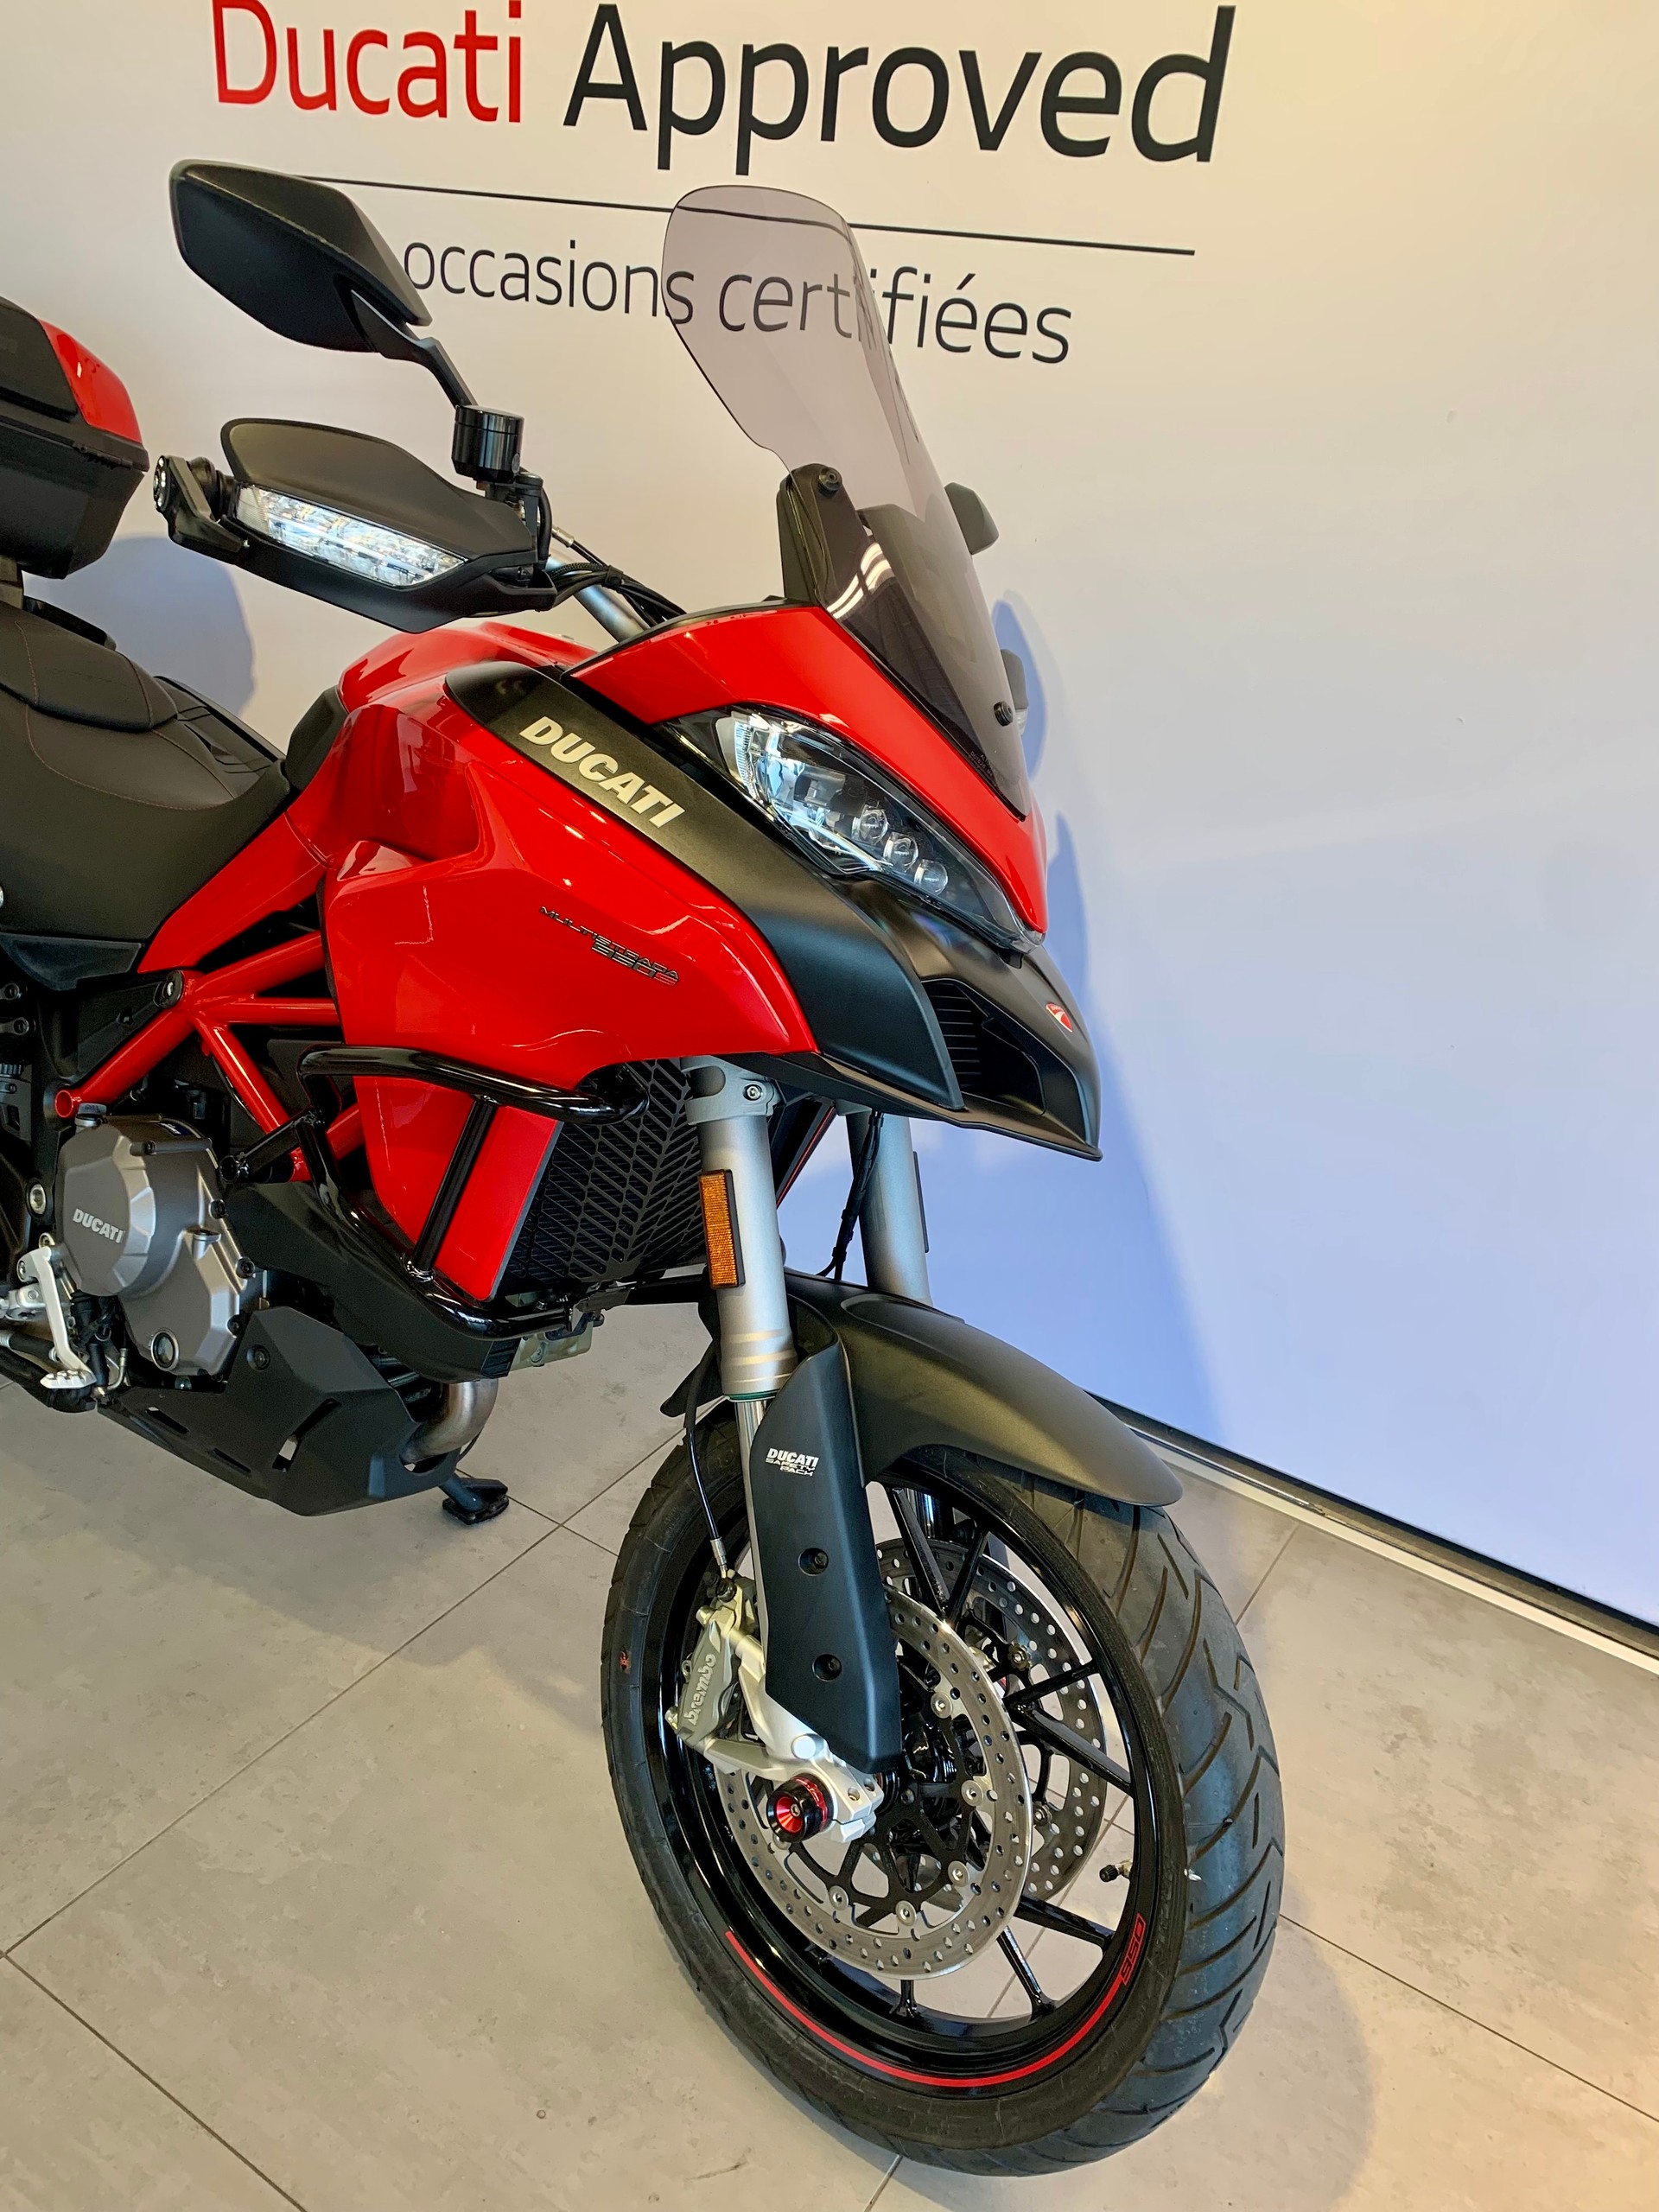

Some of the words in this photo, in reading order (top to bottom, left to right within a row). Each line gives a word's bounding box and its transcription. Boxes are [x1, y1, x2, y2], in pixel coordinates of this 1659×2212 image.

[212, 0, 522, 124] Ducati
[563, 3, 1236, 175] Approved
[404, 240, 695, 325] occasions
[518, 715, 686, 829] DUCATI
[73, 1208, 124, 1243] DUCATI
[765, 1458, 816, 1471] SAFETY
[766, 1447, 819, 1468] DUCATI
[779, 1465, 814, 1477] PACK
[683, 1654, 716, 1726] brembo
